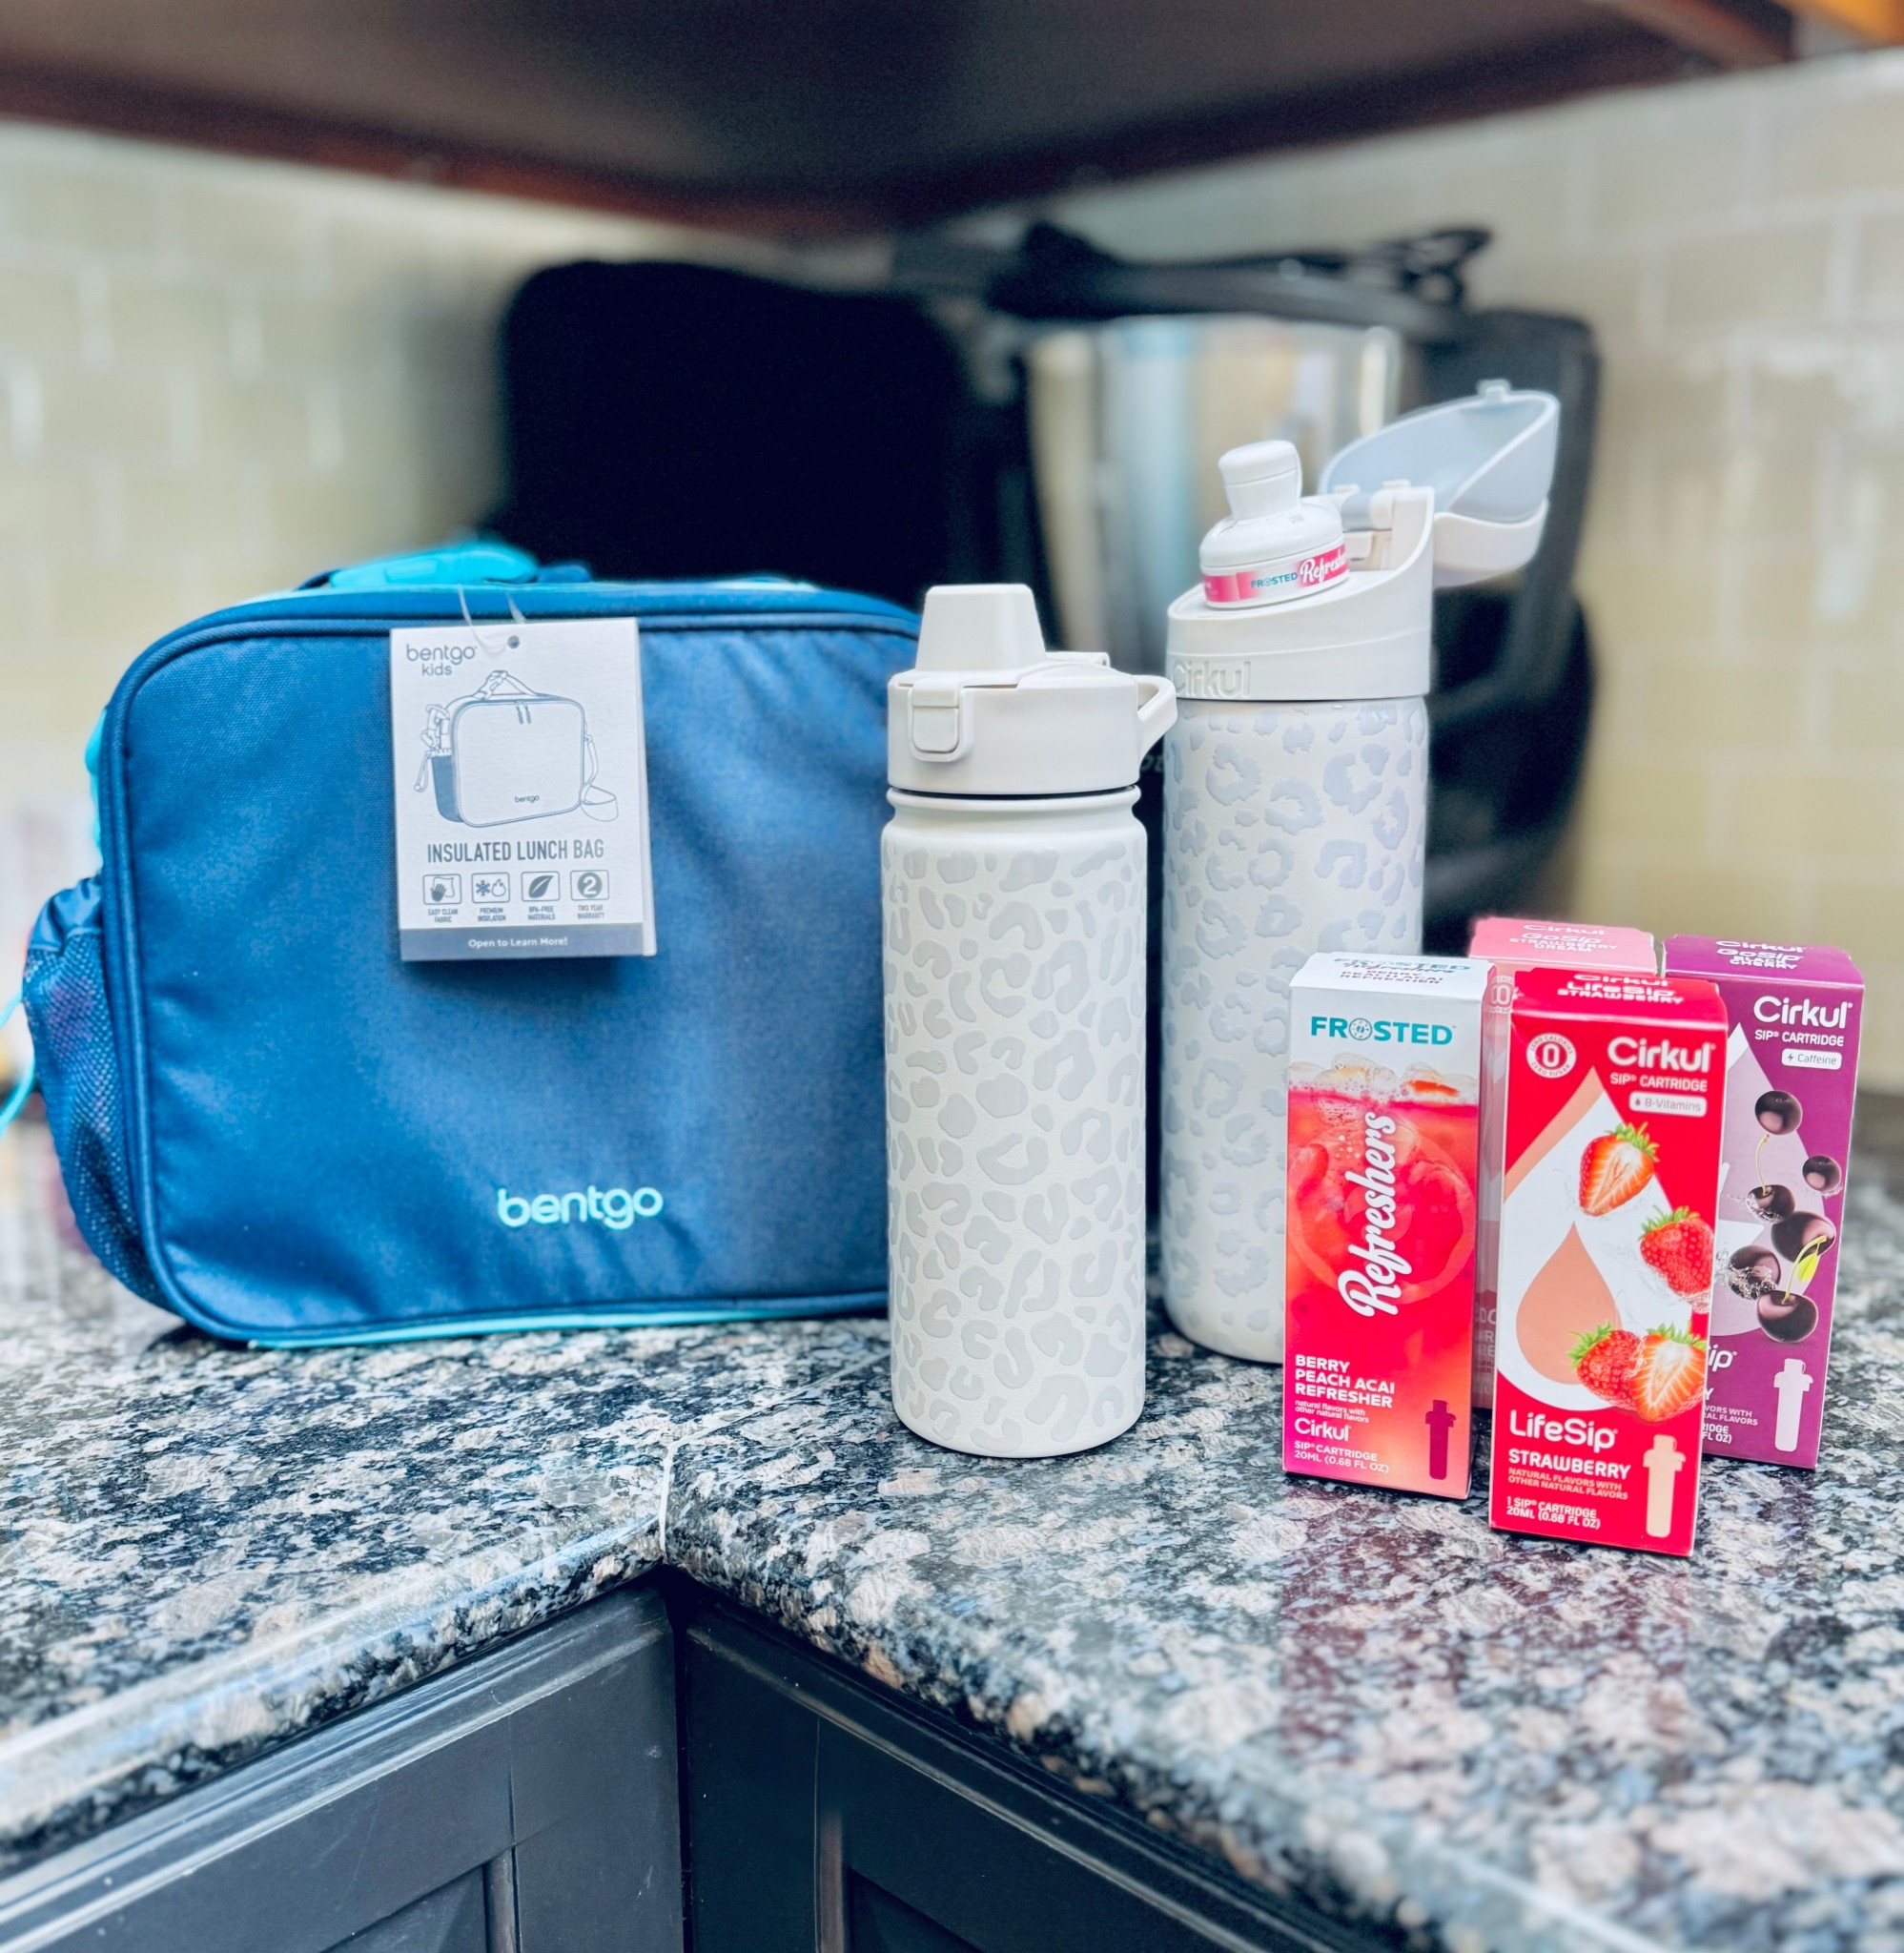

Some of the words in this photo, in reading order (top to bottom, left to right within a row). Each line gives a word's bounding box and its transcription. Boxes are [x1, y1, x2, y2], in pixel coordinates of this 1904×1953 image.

[406, 643, 476, 666] bentgo
[421, 662, 453, 676] kids
[1173, 660, 1251, 698] Cirkul
[515, 795, 540, 804] bentgo
[427, 841, 512, 863] INSULATED
[517, 840, 568, 861] LUNCH
[573, 838, 604, 859] BAG
[468, 938, 495, 950] Open
[497, 939, 508, 948] to
[510, 938, 538, 948] Learn
[540, 936, 568, 947] More!
[1311, 1016, 1453, 1046] FROSTED
[1781, 1031, 1845, 1047] CARTRIDGE
[1797, 1053, 1837, 1065] Caffeine
[1640, 1074, 1708, 1093] CARTRIDGE
[1645, 1097, 1702, 1113] B-Vitamins
[498, 1185, 664, 1230] bentgo
[1338, 1112, 1413, 1317] Refreshers
[1295, 1354, 1351, 1373] BERRY
[1295, 1367, 1351, 1388] PEACH
[1354, 1377, 1396, 1394] ACAI
[1295, 1382, 1393, 1408] REFRESHER
[1295, 1400, 1321, 1409] natural
[1321, 1403, 1349, 1413] flavors
[1349, 1407, 1366, 1416] with
[1295, 1406, 1315, 1415] other
[1316, 1409, 1342, 1419] natural
[1343, 1413, 1370, 1424] flavors
[1729, 1408, 1752, 1418] WITH
[1719, 1413, 1758, 1427] FLAVORS
[1715, 1432, 1732, 1445] OZ)
[1294, 1449, 1322, 1463] 20ML
[1324, 1455, 1352, 1468] (0.68
[1354, 1460, 1366, 1470] FL
[1369, 1463, 1390, 1474] OZ)
[1316, 1444, 1378, 1462] CARTRIDGE
[1508, 1448, 1631, 1480] STRAWBERRY
[1508, 1467, 1552, 1482] NATURAL
[1553, 1474, 1595, 1488] FLAVORS
[1596, 1479, 1623, 1491] WITH
[1508, 1475, 1540, 1488] OTHER
[1541, 1479, 1585, 1495] NATURAL
[1586, 1487, 1628, 1501] FLAVORS
[1506, 1495, 1512, 1507] 1
[1538, 1501, 1597, 1519] CARTRIDGE
[1506, 1506, 1536, 1520] 20ML
[1538, 1511, 1566, 1524] (0.68
[1567, 1515, 1580, 1526] FL
[1582, 1517, 1602, 1531] OZ)
